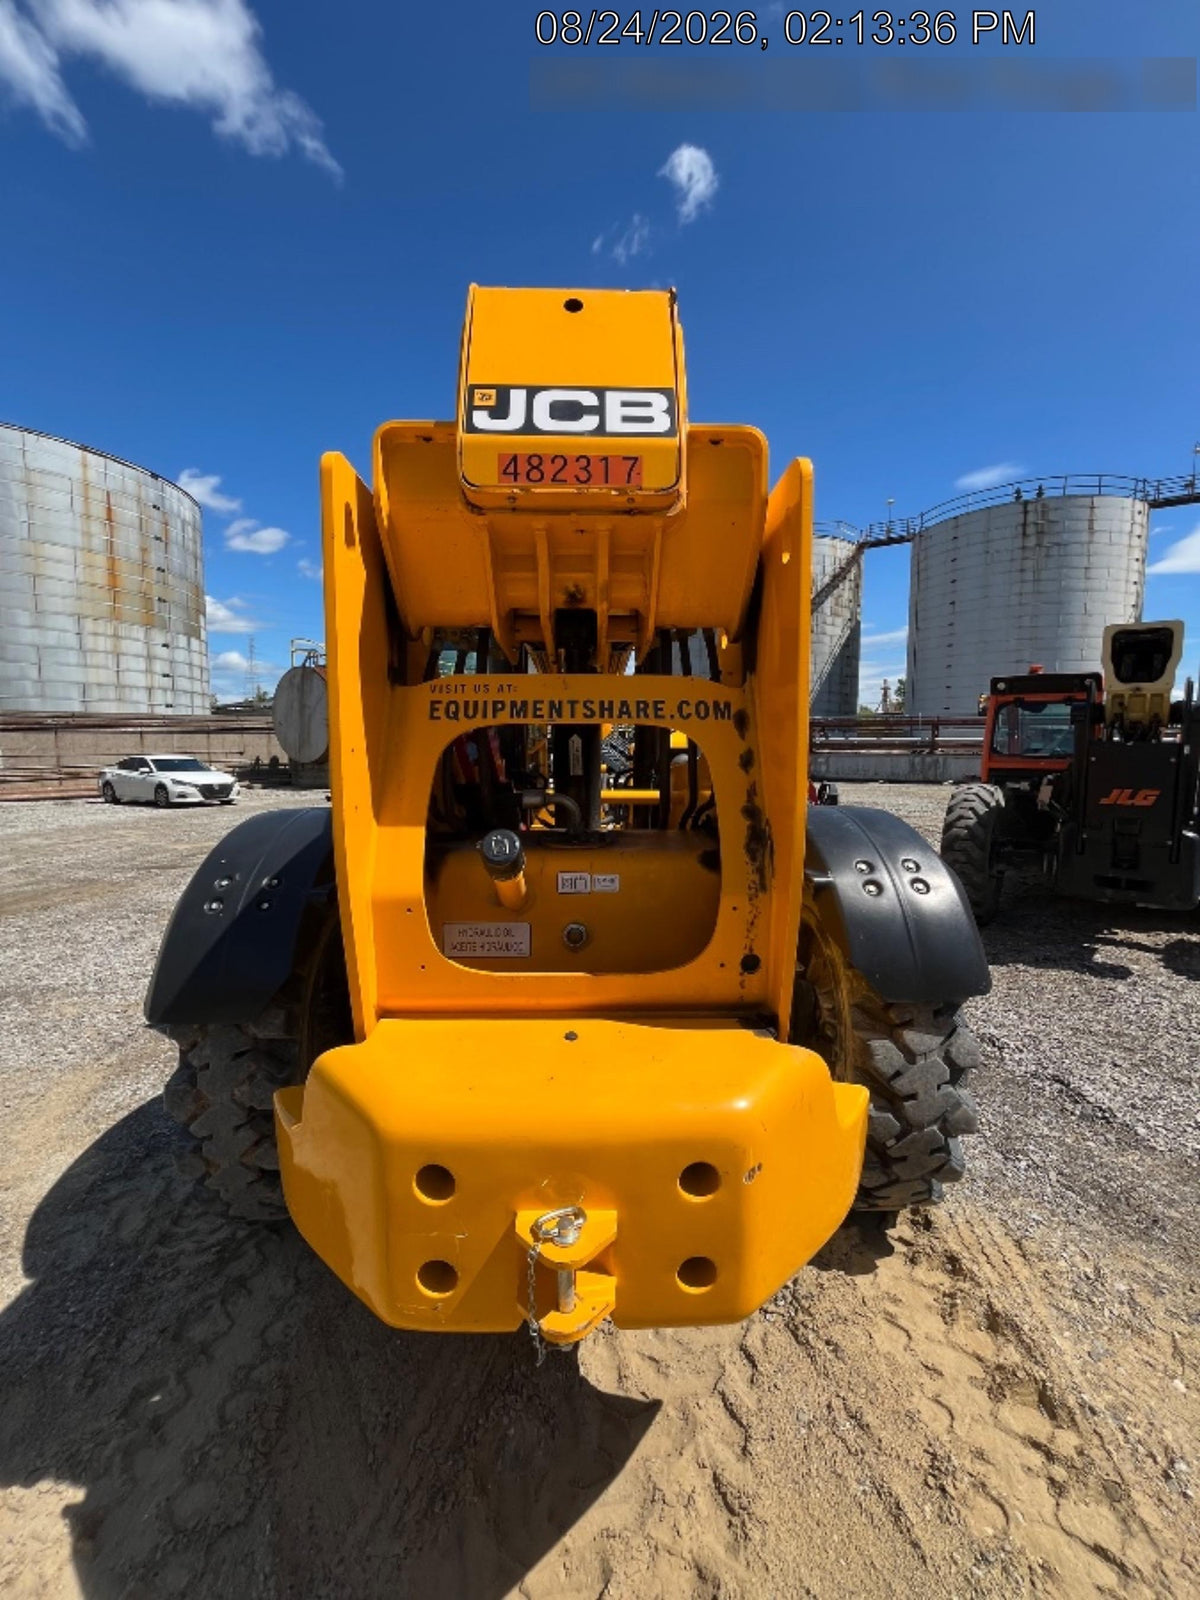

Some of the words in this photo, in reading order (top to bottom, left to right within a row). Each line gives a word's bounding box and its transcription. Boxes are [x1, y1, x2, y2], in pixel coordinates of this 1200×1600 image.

[472, 388, 672, 433] JCB
[502, 453, 639, 484] 482317
[430, 683, 466, 694] VISIT
[474, 683, 490, 694] US
[497, 683, 518, 694] AT:
[428, 699, 733, 721] EQUIPMENTSHARE.COM
[1098, 788, 1162, 806] JLG
